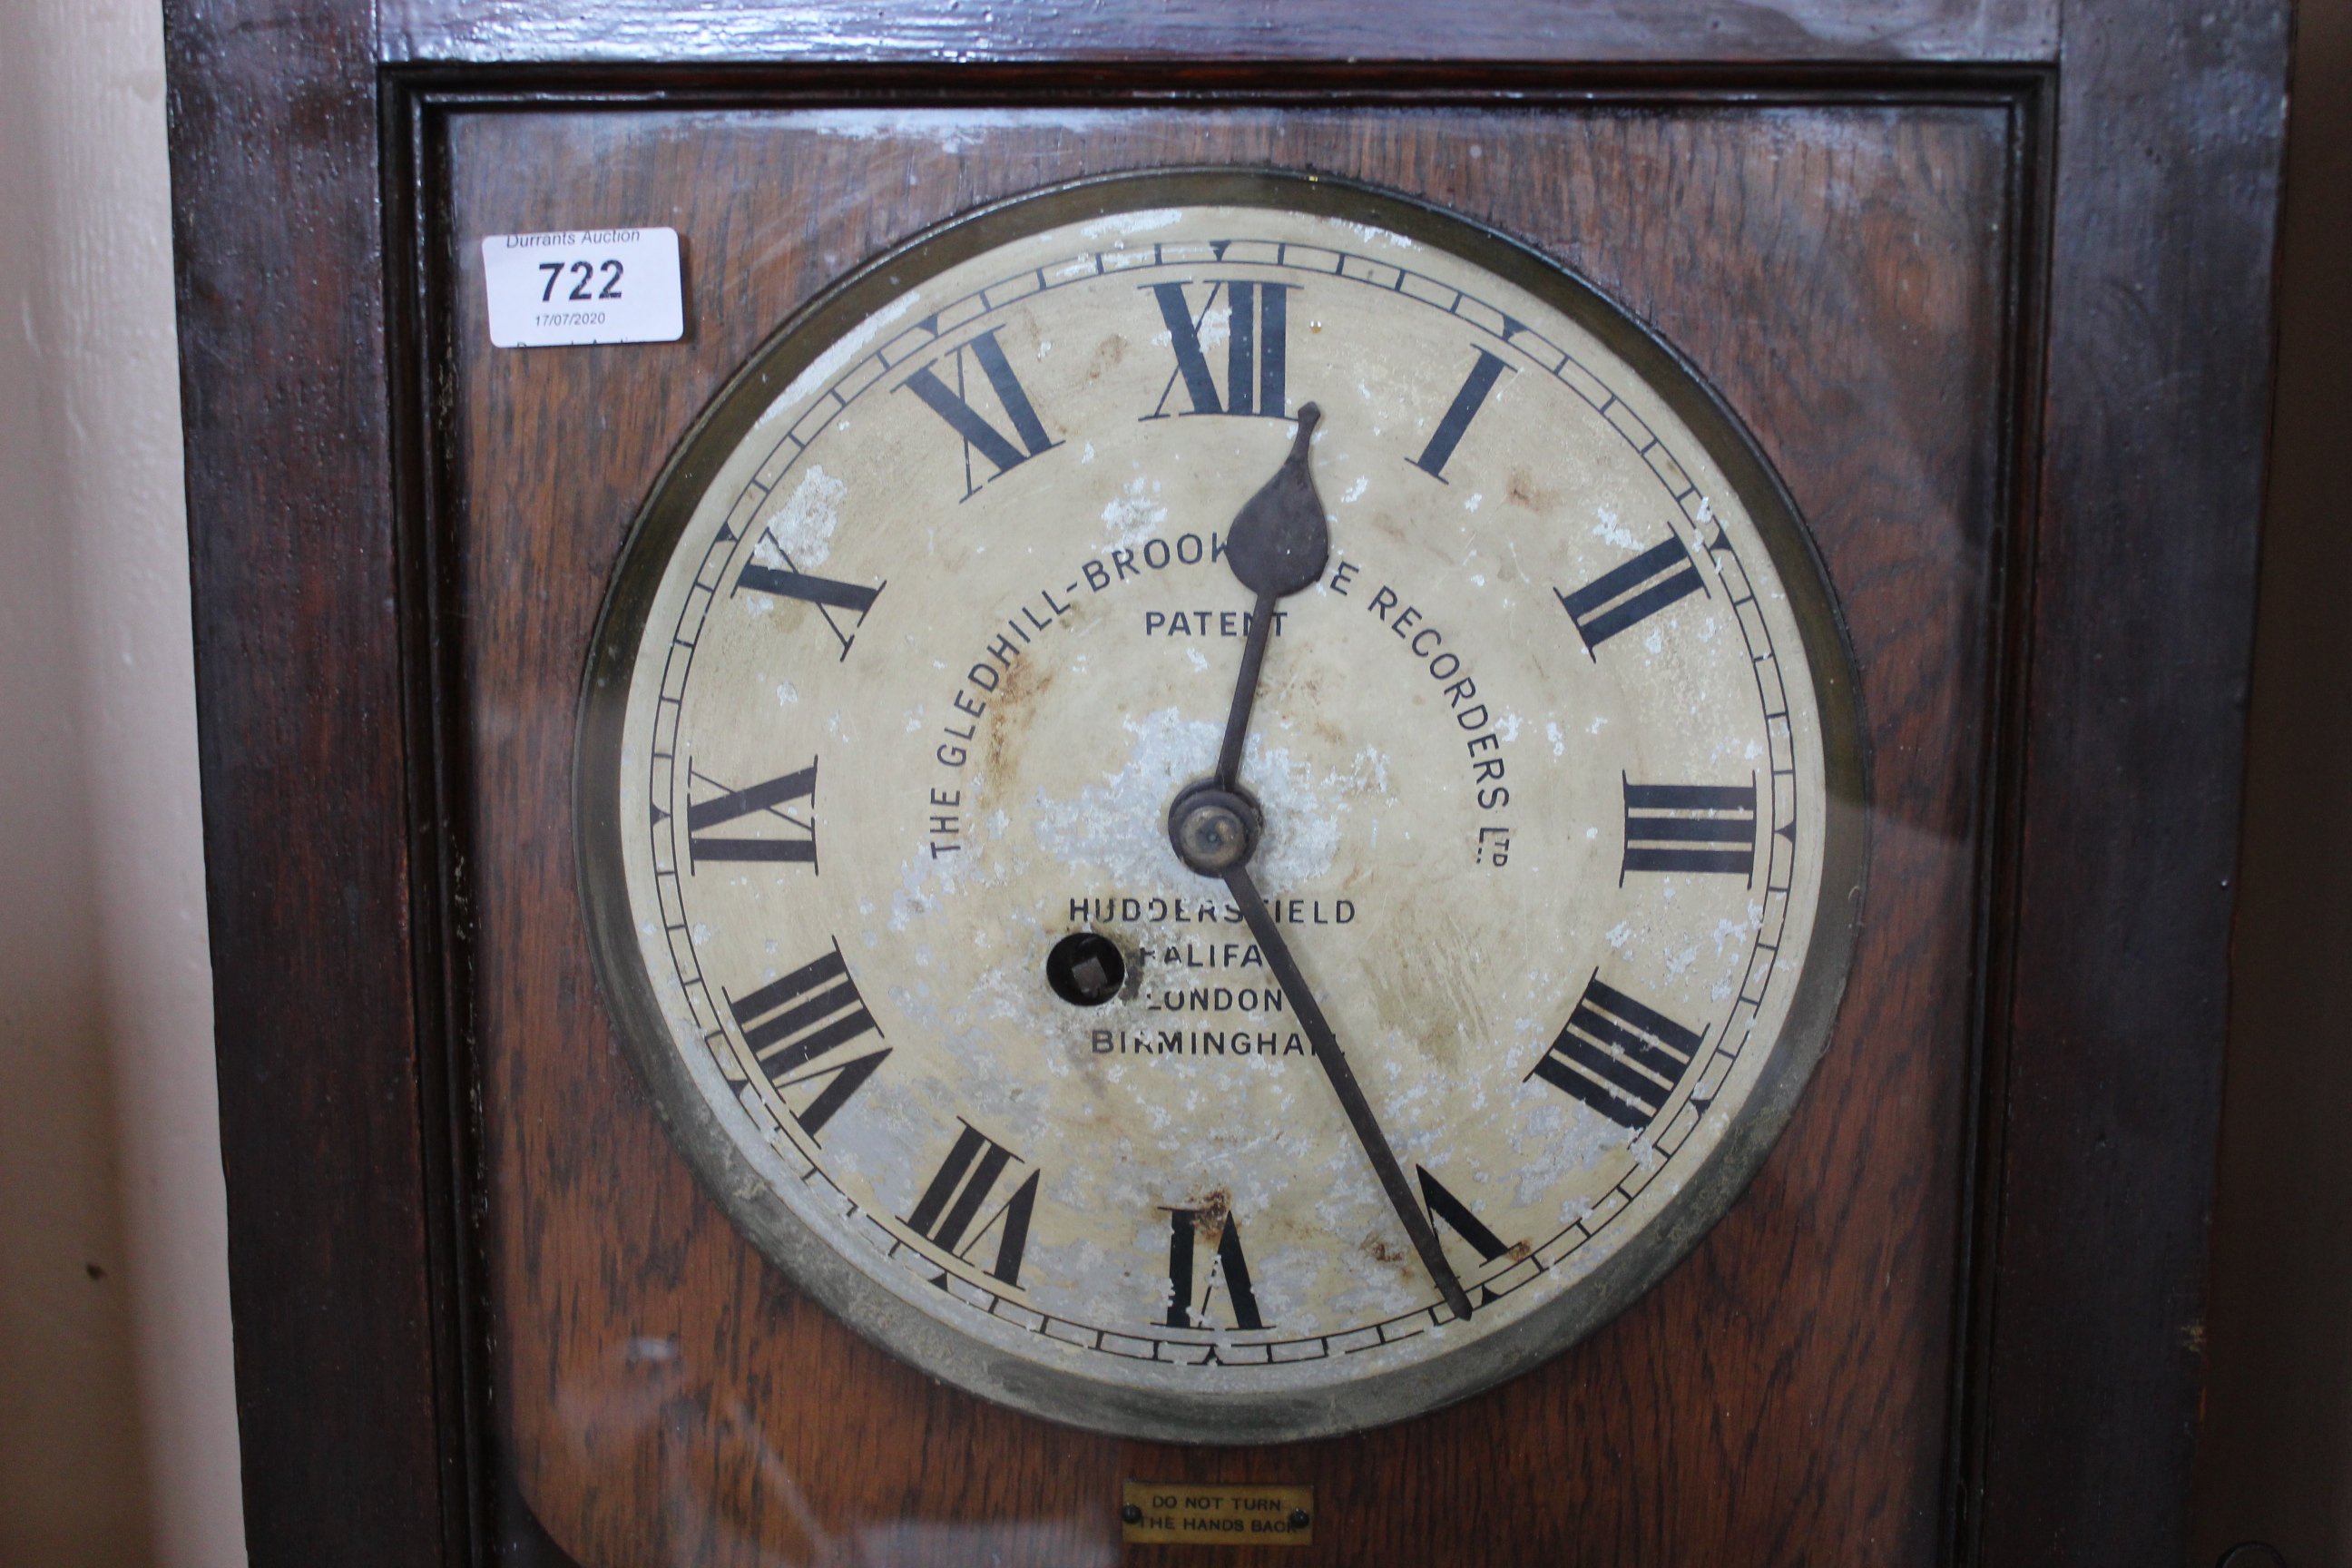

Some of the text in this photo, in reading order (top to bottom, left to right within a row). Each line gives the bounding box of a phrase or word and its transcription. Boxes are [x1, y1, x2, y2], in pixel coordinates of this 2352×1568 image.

[505, 229, 641, 250] Durrants Auction
[538, 260, 624, 302] 722
[535, 313, 606, 328] 17/07/2020
[1138, 279, 1304, 422] XII
[929, 787, 962, 859] THE
[1367, 585, 1510, 809] RECORDERS
[1069, 897, 1357, 924] HUDDERSIELD
[1139, 943, 1289, 968] HALIFA
[1092, 1029, 1346, 1057] BIRMINGHA
[1152, 1496, 1281, 1511] DO NOT TURN
[1140, 1517, 1176, 1530] THE
[1183, 1518, 1244, 1532] HANDS
